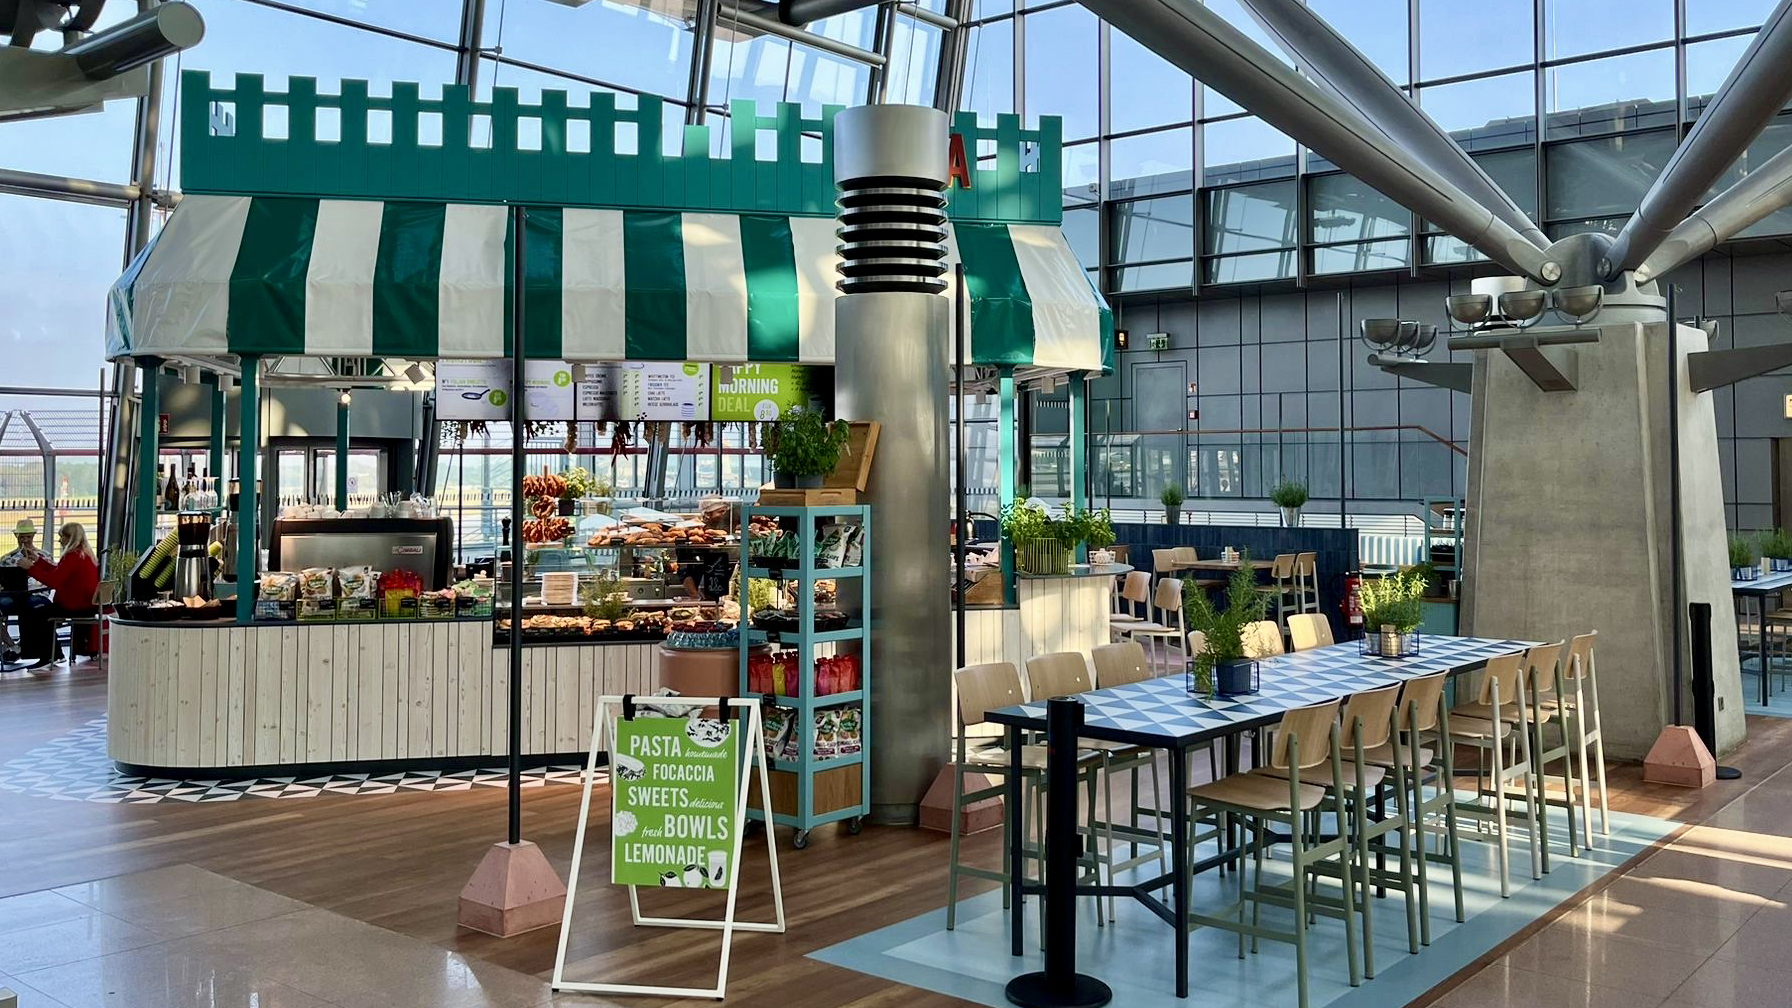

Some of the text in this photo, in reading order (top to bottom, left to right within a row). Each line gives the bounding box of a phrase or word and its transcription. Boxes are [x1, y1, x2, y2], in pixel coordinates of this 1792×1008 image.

[949, 133, 971, 188] A
[718, 378, 779, 394] MORNING
[718, 397, 751, 412] DEAL
[630, 735, 728, 759] PASTA homemade
[653, 763, 714, 782] FOCACCIA
[628, 785, 724, 810] SWEETS delicious
[641, 814, 729, 840] fresh BOWLS
[624, 843, 706, 866] LEMONADE
